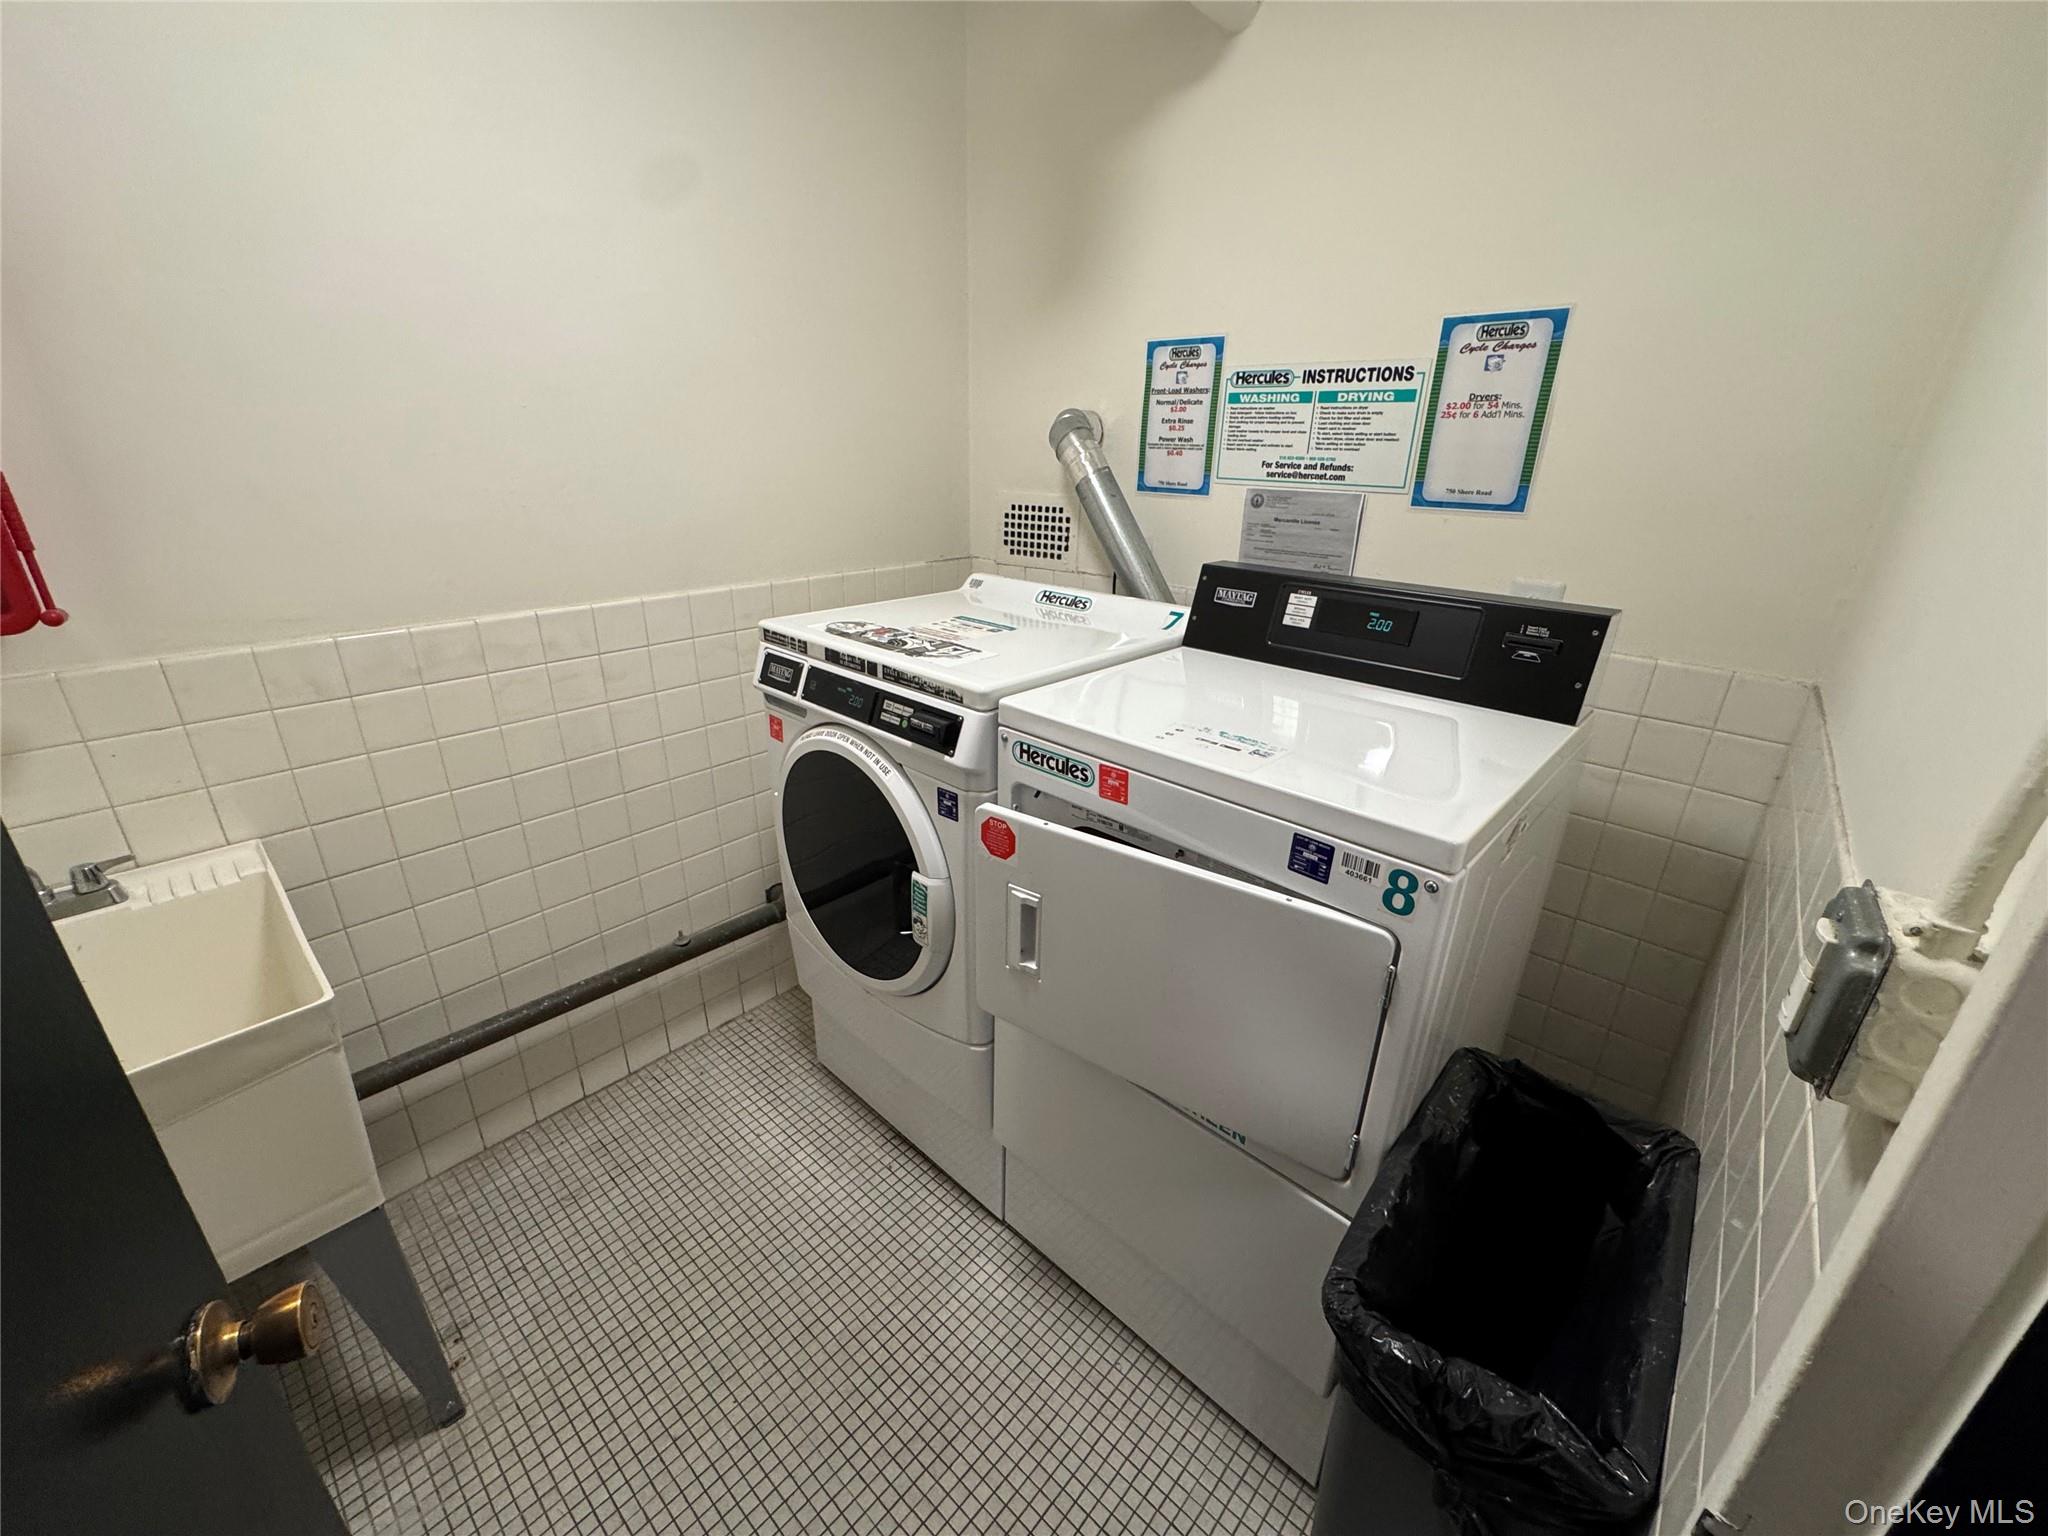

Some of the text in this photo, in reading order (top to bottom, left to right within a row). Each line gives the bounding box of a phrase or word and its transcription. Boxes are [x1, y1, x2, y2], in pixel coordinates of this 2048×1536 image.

[1480, 322, 1526, 338] Hercules
[1171, 347, 1200, 359] Hercules
[1459, 340, 1537, 354] Cycle Charges
[1179, 360, 1207, 370] Charges
[1235, 365, 1415, 385] Hercules INSTRUCTIONS
[1239, 392, 1300, 403] WASHING
[1336, 391, 1395, 403] DRYING
[1468, 393, 1503, 403] Dryers:
[1446, 401, 1523, 410] $2.00 for 54 Mins.
[1440, 411, 1457, 420] 25¢
[1459, 411, 1471, 419] for
[1503, 410, 1525, 419] Mins.
[1261, 460, 1354, 472] For Service and Refunds:
[1266, 470, 1346, 481] service@hercnet.com
[1040, 590, 1089, 610] Hercules
[1217, 589, 1254, 602] MAYTAG
[1162, 611, 1184, 630] 7
[1366, 618, 1393, 632] 2.00
[837, 733, 850, 744] OPEN
[849, 739, 864, 752] WHEN
[863, 749, 875, 760] NOT
[873, 756, 881, 766] IN
[879, 763, 892, 777] USE
[1019, 742, 1089, 783] Hercules
[988, 818, 1007, 830] STOP
[1345, 869, 1373, 883] 403661
[1382, 868, 1419, 916] 8
